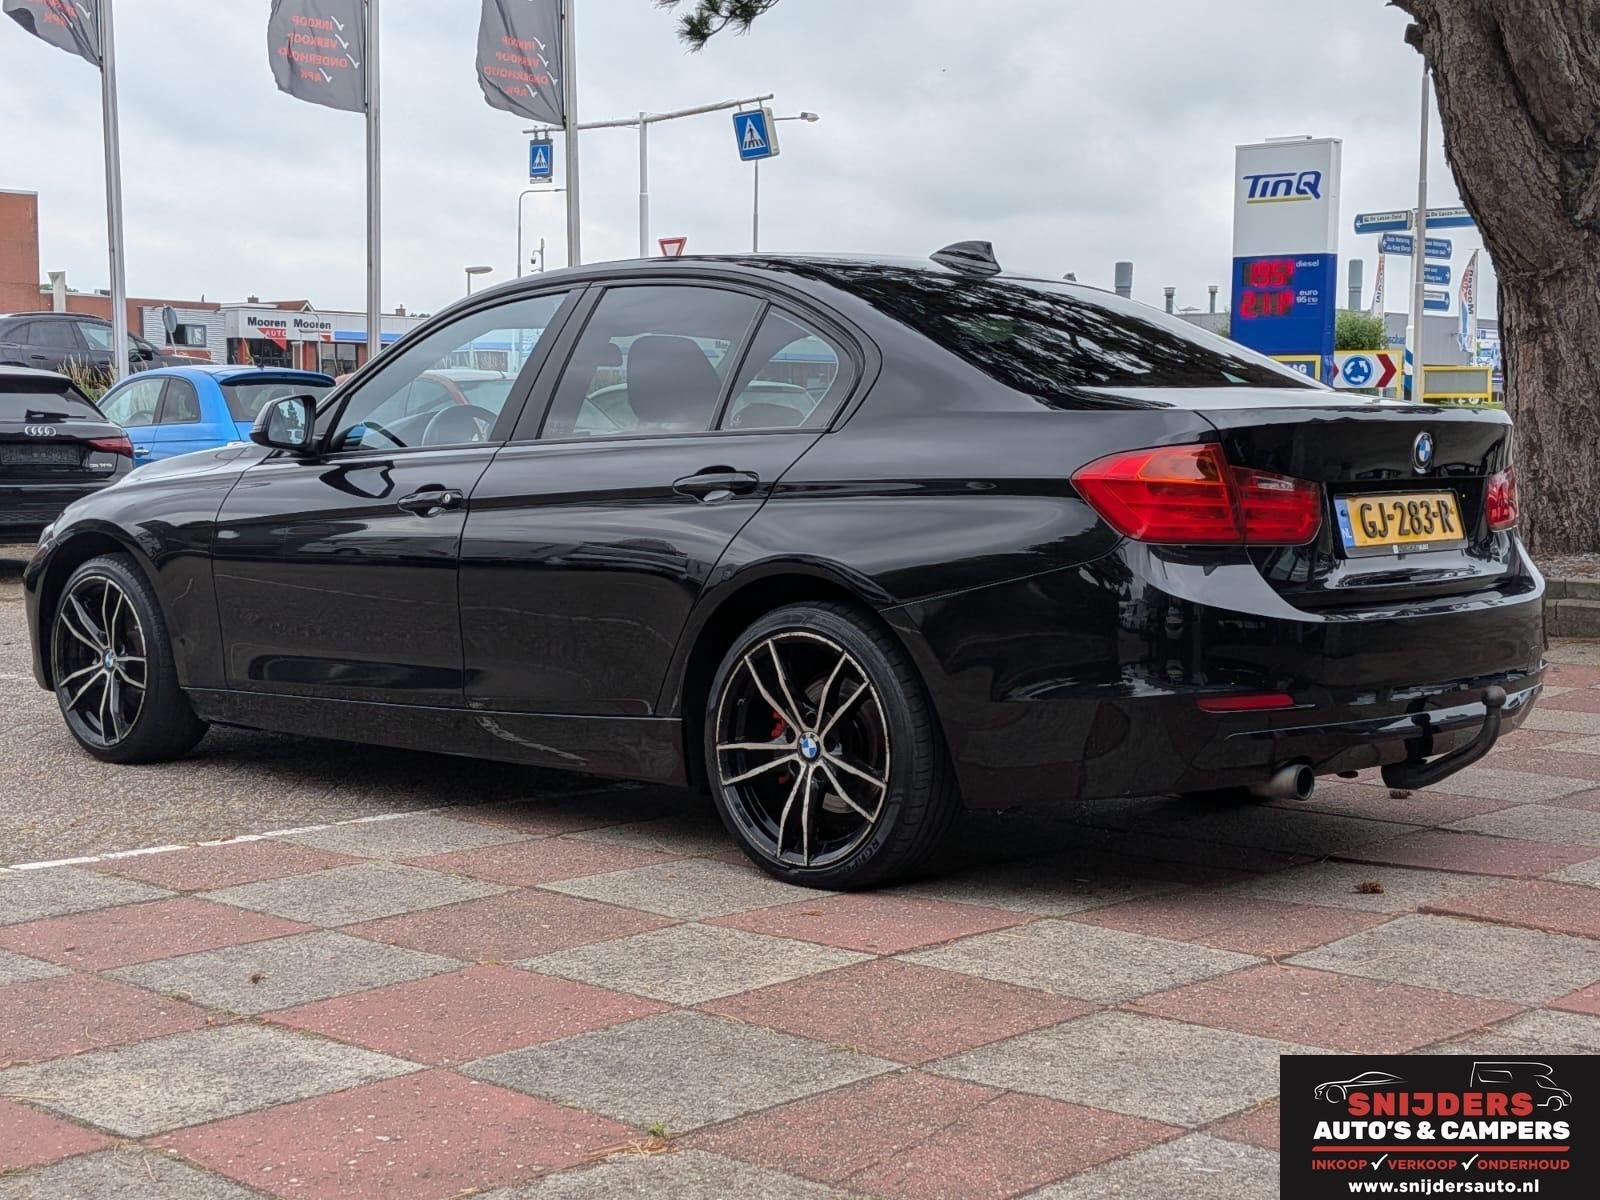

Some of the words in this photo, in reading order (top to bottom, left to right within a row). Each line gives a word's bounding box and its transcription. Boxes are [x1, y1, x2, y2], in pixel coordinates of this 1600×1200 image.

[1295, 259, 1320, 268] diesel
[247, 316, 287, 328] Mooren
[294, 318, 332, 330] Mooren
[1360, 500, 1455, 539] GJ-283-R
